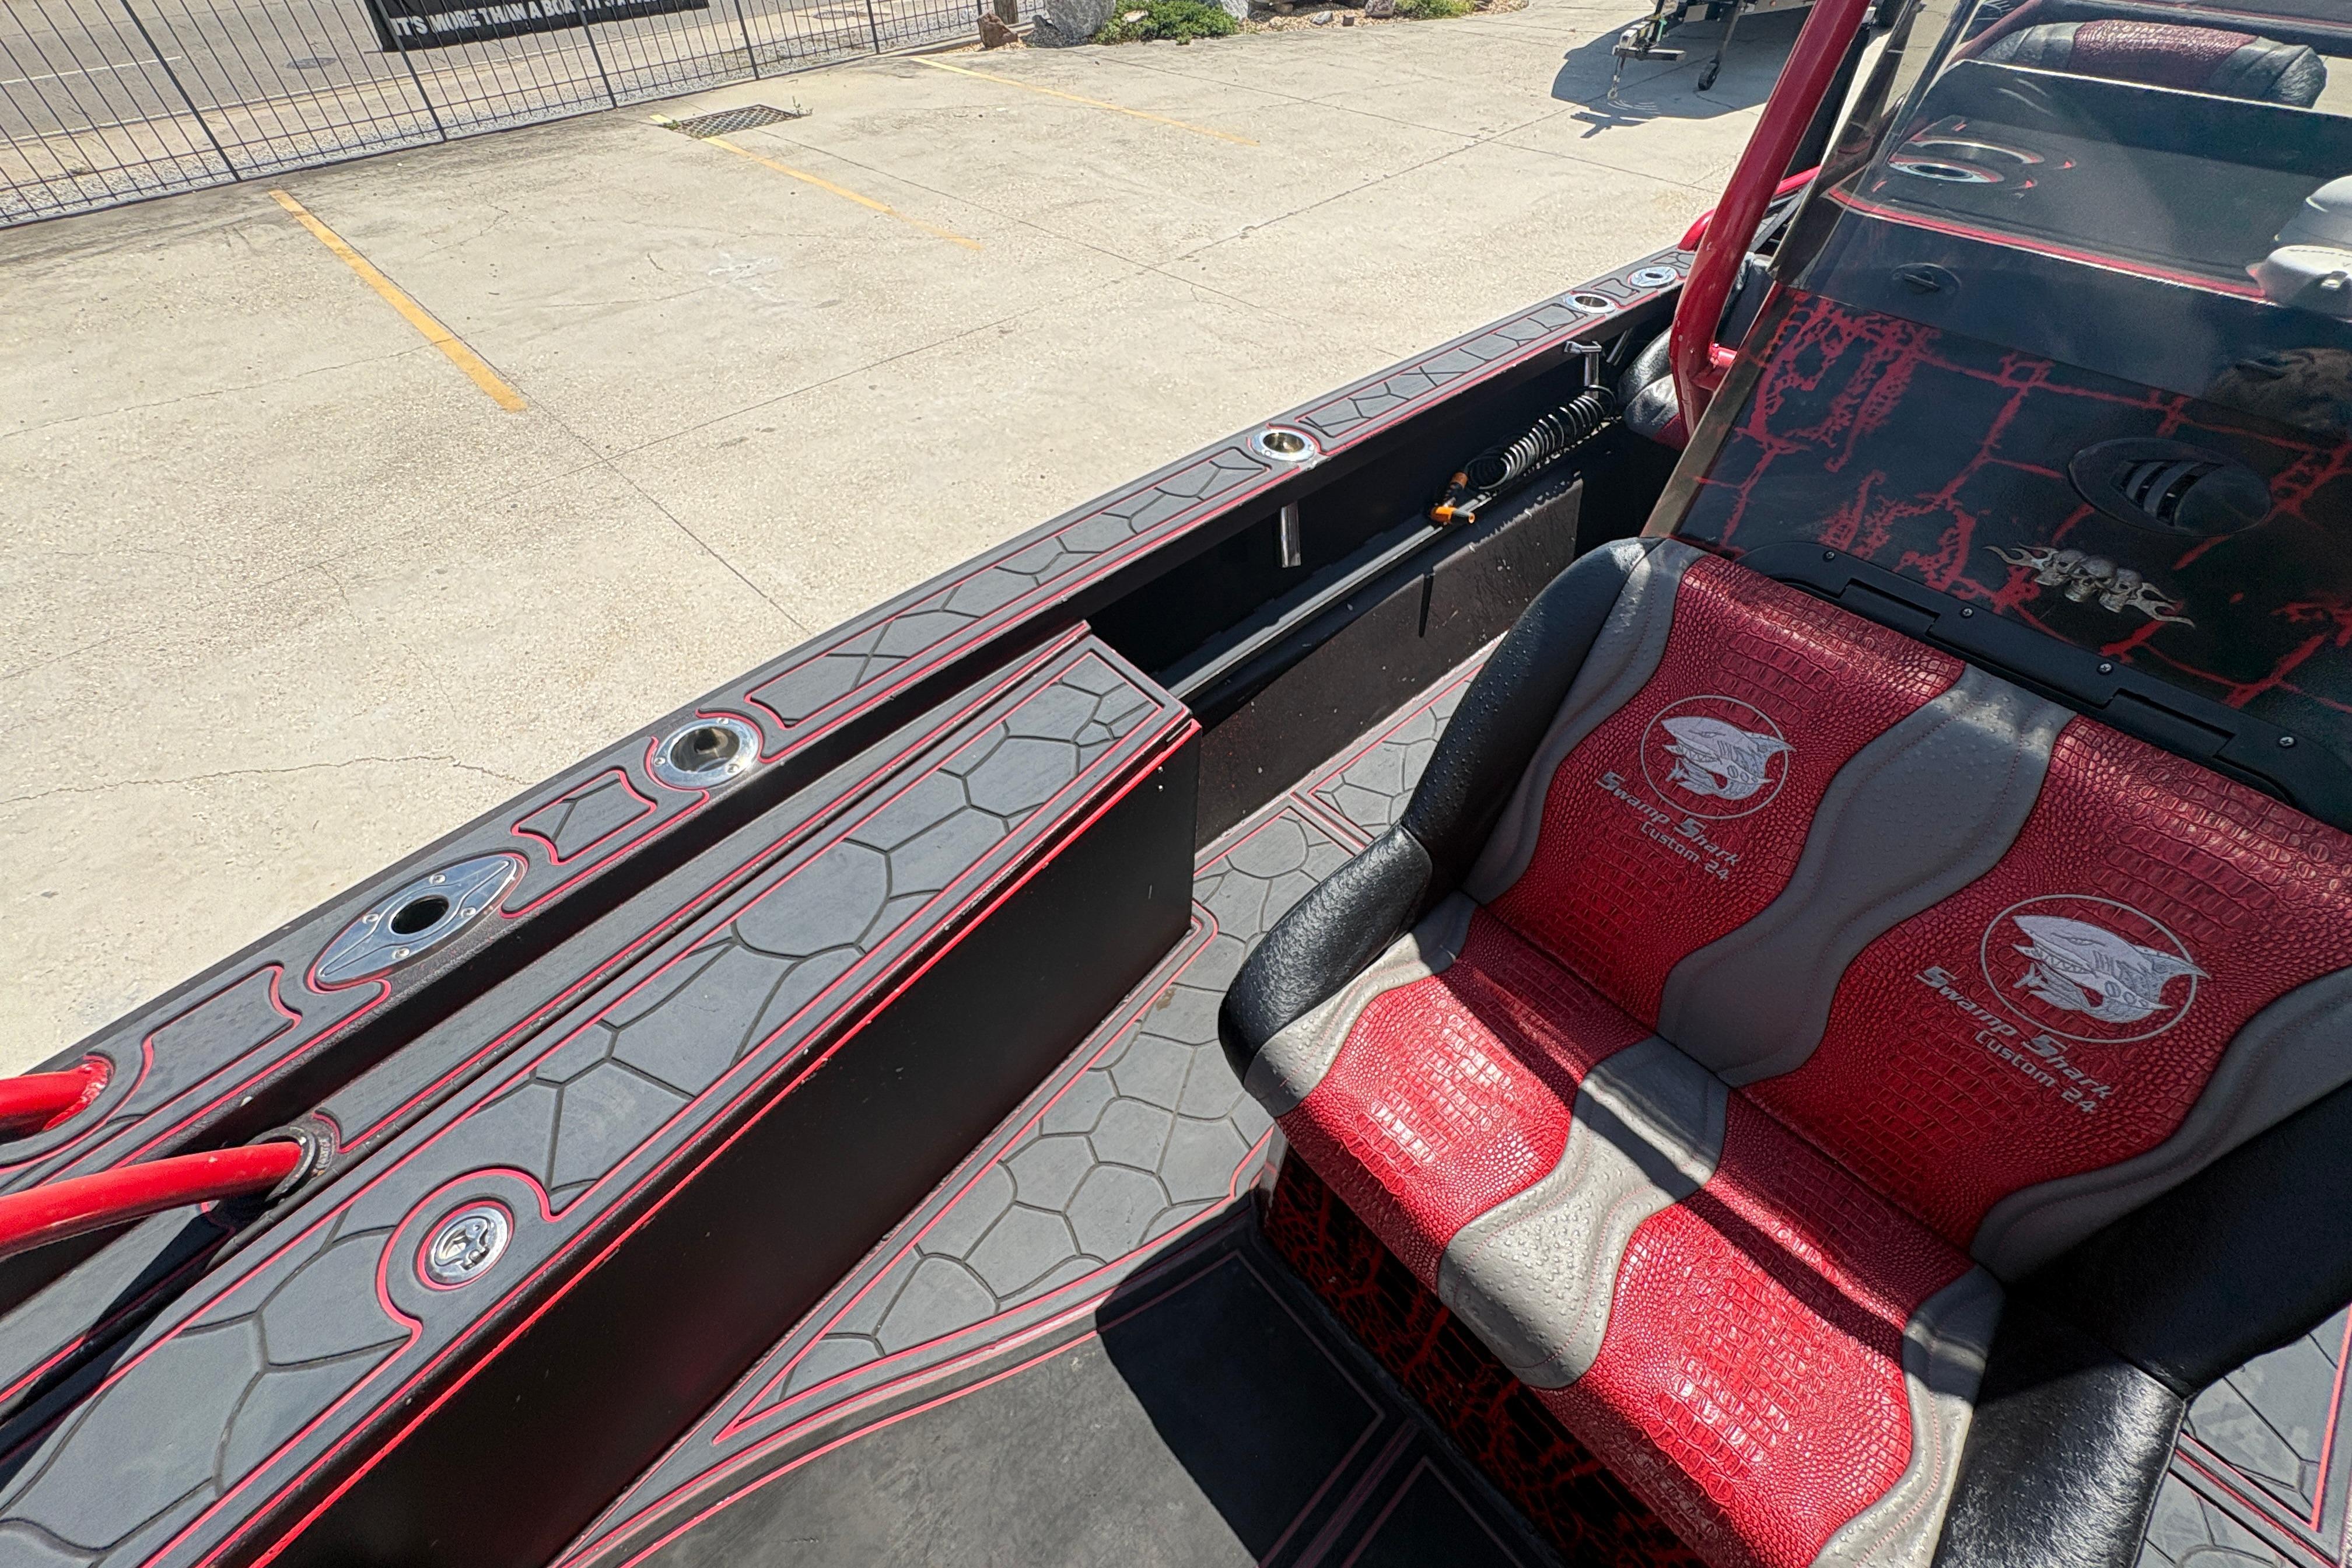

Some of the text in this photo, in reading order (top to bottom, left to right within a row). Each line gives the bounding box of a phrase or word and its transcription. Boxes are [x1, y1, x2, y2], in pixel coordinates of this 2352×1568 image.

[390, 16, 428, 36] IT'S
[426, 10, 481, 33] MORE
[478, 3, 528, 25] THAN
[528, 1, 543, 19] A
[1596, 771, 1740, 866] Swamp Shark
[1640, 821, 1729, 880] Custom 24
[1915, 966, 2113, 1100] Swamp Shark
[1975, 1030, 2096, 1112] Custom 24
